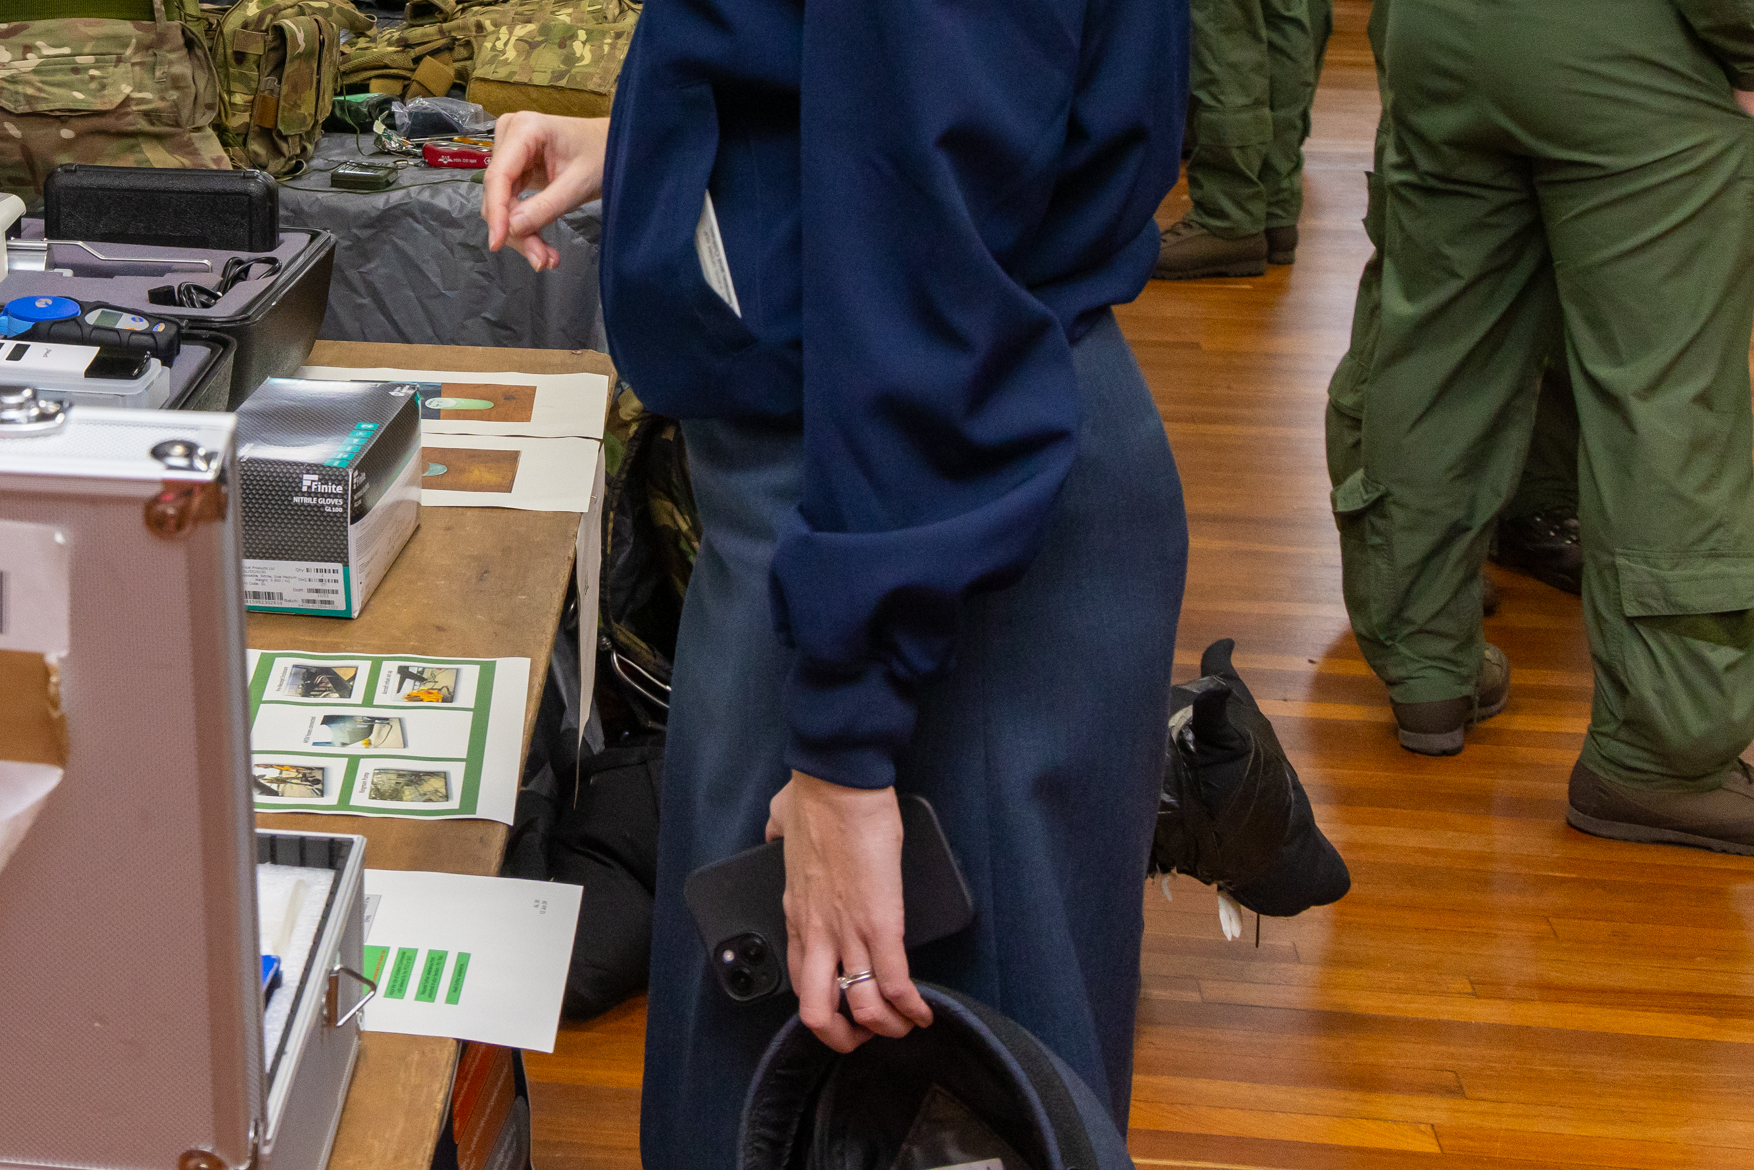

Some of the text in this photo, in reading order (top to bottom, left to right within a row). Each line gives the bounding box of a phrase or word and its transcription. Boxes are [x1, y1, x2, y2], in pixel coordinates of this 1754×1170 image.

[311, 481, 343, 493] Finite
[293, 496, 343, 506] NITRILE GLOVES
